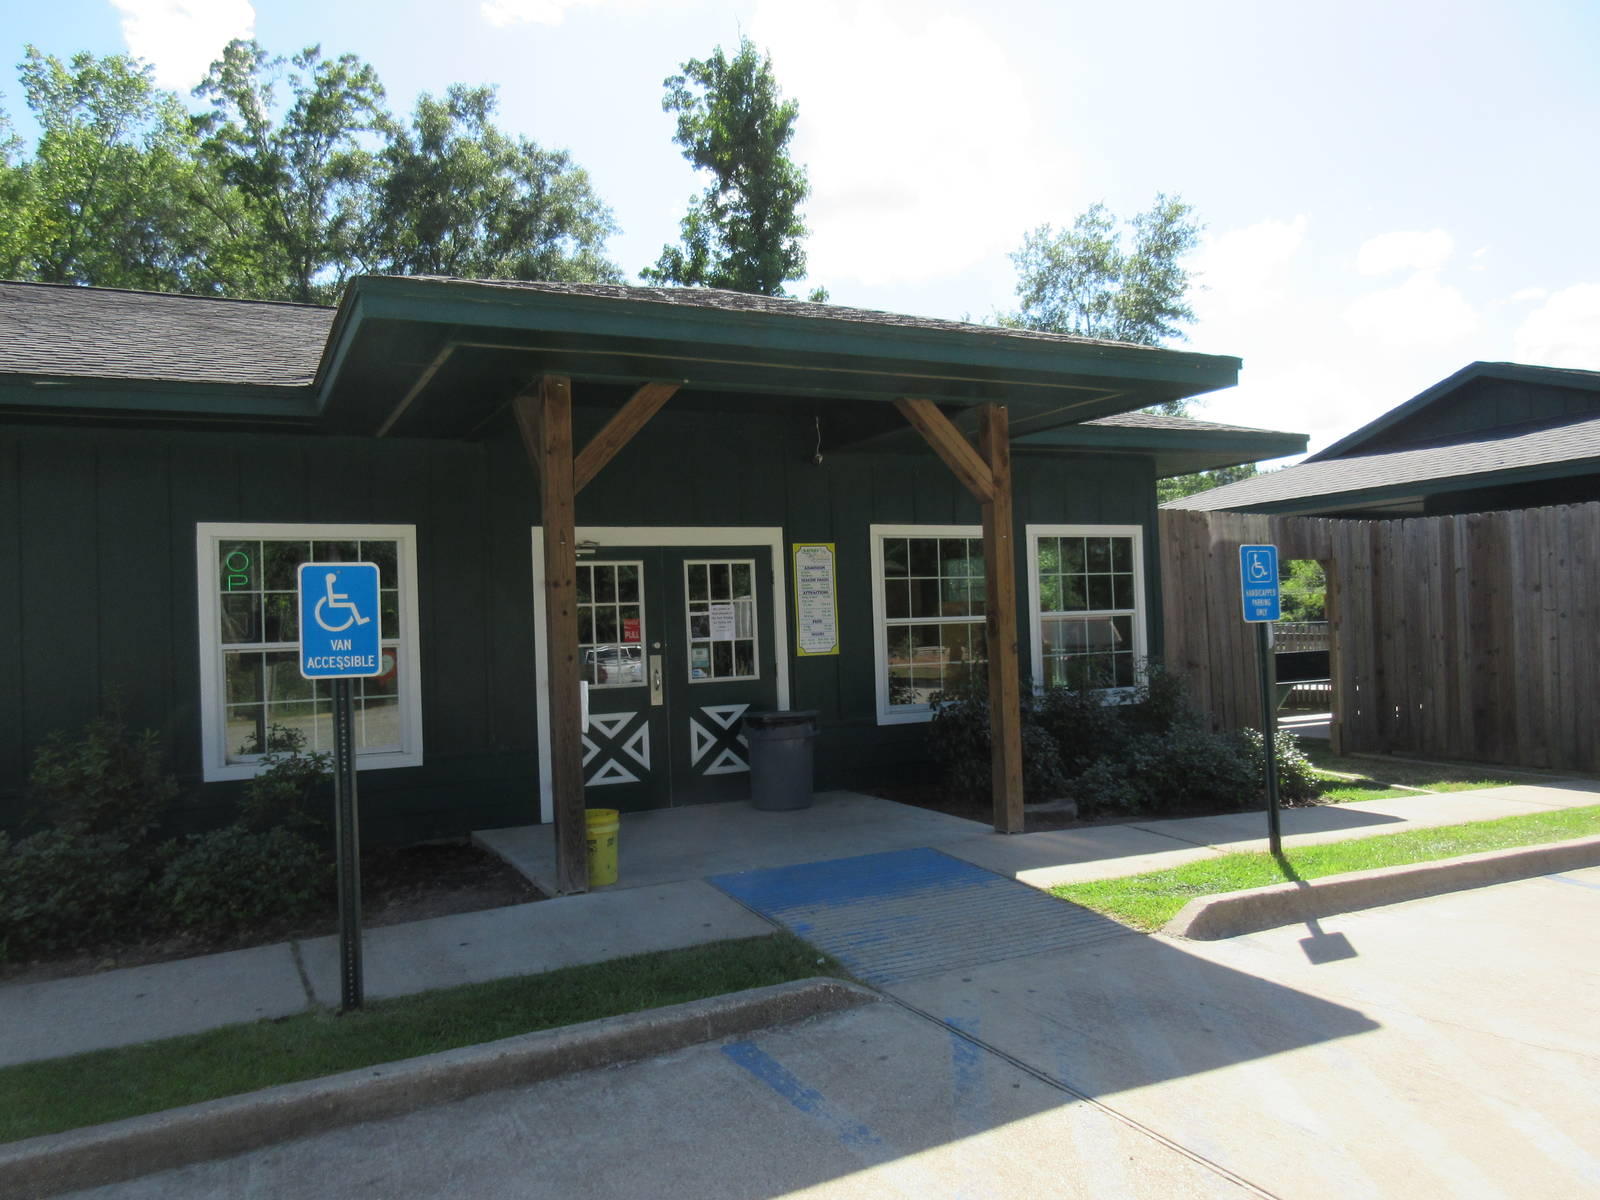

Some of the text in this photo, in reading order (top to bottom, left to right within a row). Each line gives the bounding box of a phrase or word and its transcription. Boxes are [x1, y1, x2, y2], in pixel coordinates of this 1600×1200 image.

[1252, 598, 1272, 606] PARKING
[1256, 608, 1268, 616] ONLY
[624, 631, 640, 639] PULL
[330, 640, 352, 651] VAN
[307, 655, 375, 669] ACCESSIBLE
